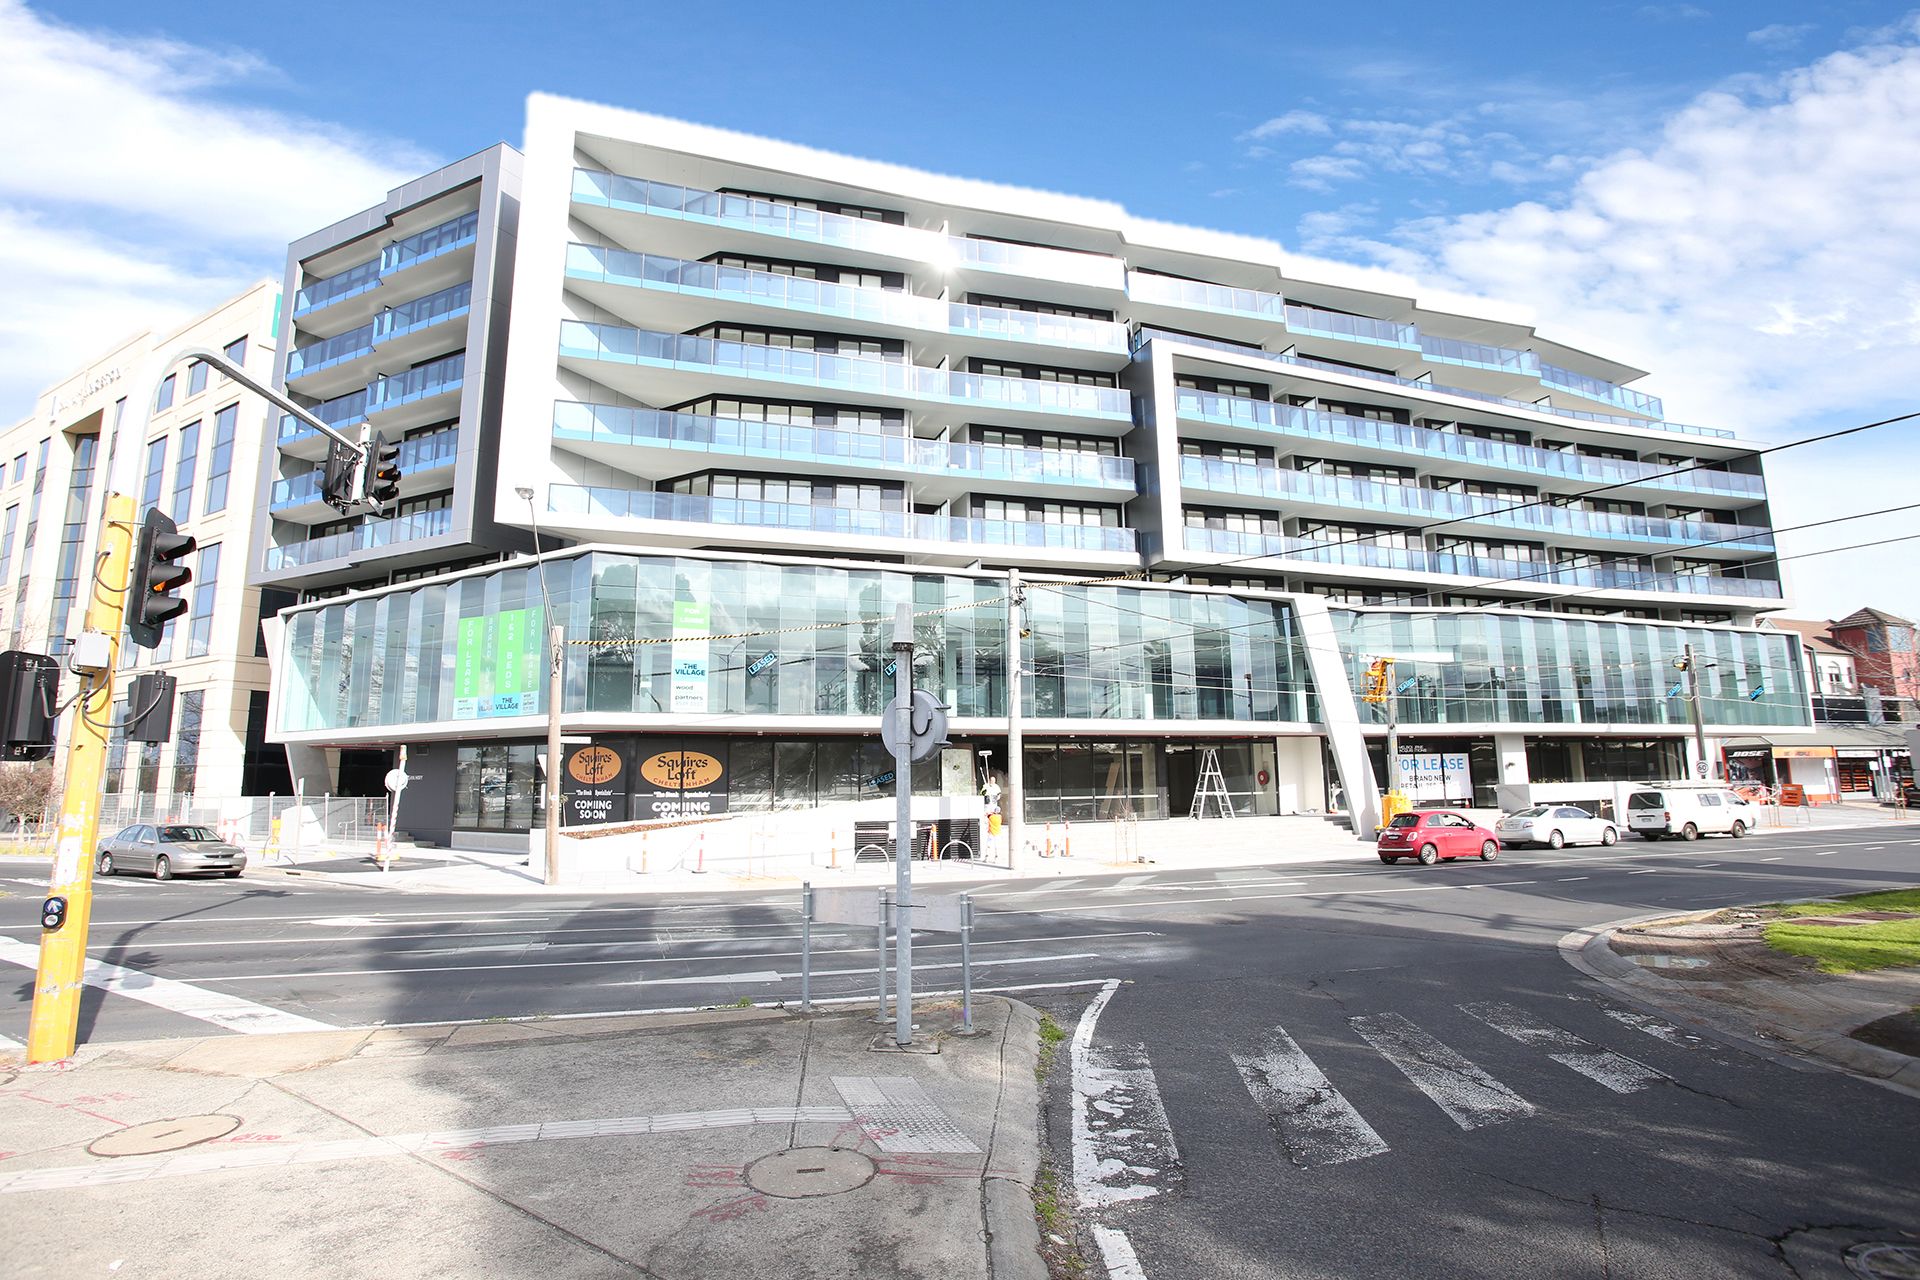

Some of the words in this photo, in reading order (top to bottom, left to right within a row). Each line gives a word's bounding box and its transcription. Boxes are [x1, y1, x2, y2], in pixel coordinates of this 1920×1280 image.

[748, 652, 776, 675] LEASED
[578, 751, 612, 766] Squires
[657, 755, 708, 771] Squires
[1399, 758, 1419, 771] OR
[1423, 758, 1464, 771] LEASE
[585, 763, 605, 776] Loft
[667, 768, 696, 780] Loft
[575, 772, 613, 782] CHELTNHAM
[1409, 774, 1432, 782] BRAND
[574, 799, 612, 810] COMING
[651, 801, 711, 812] COMING
[579, 809, 606, 819] SOON
